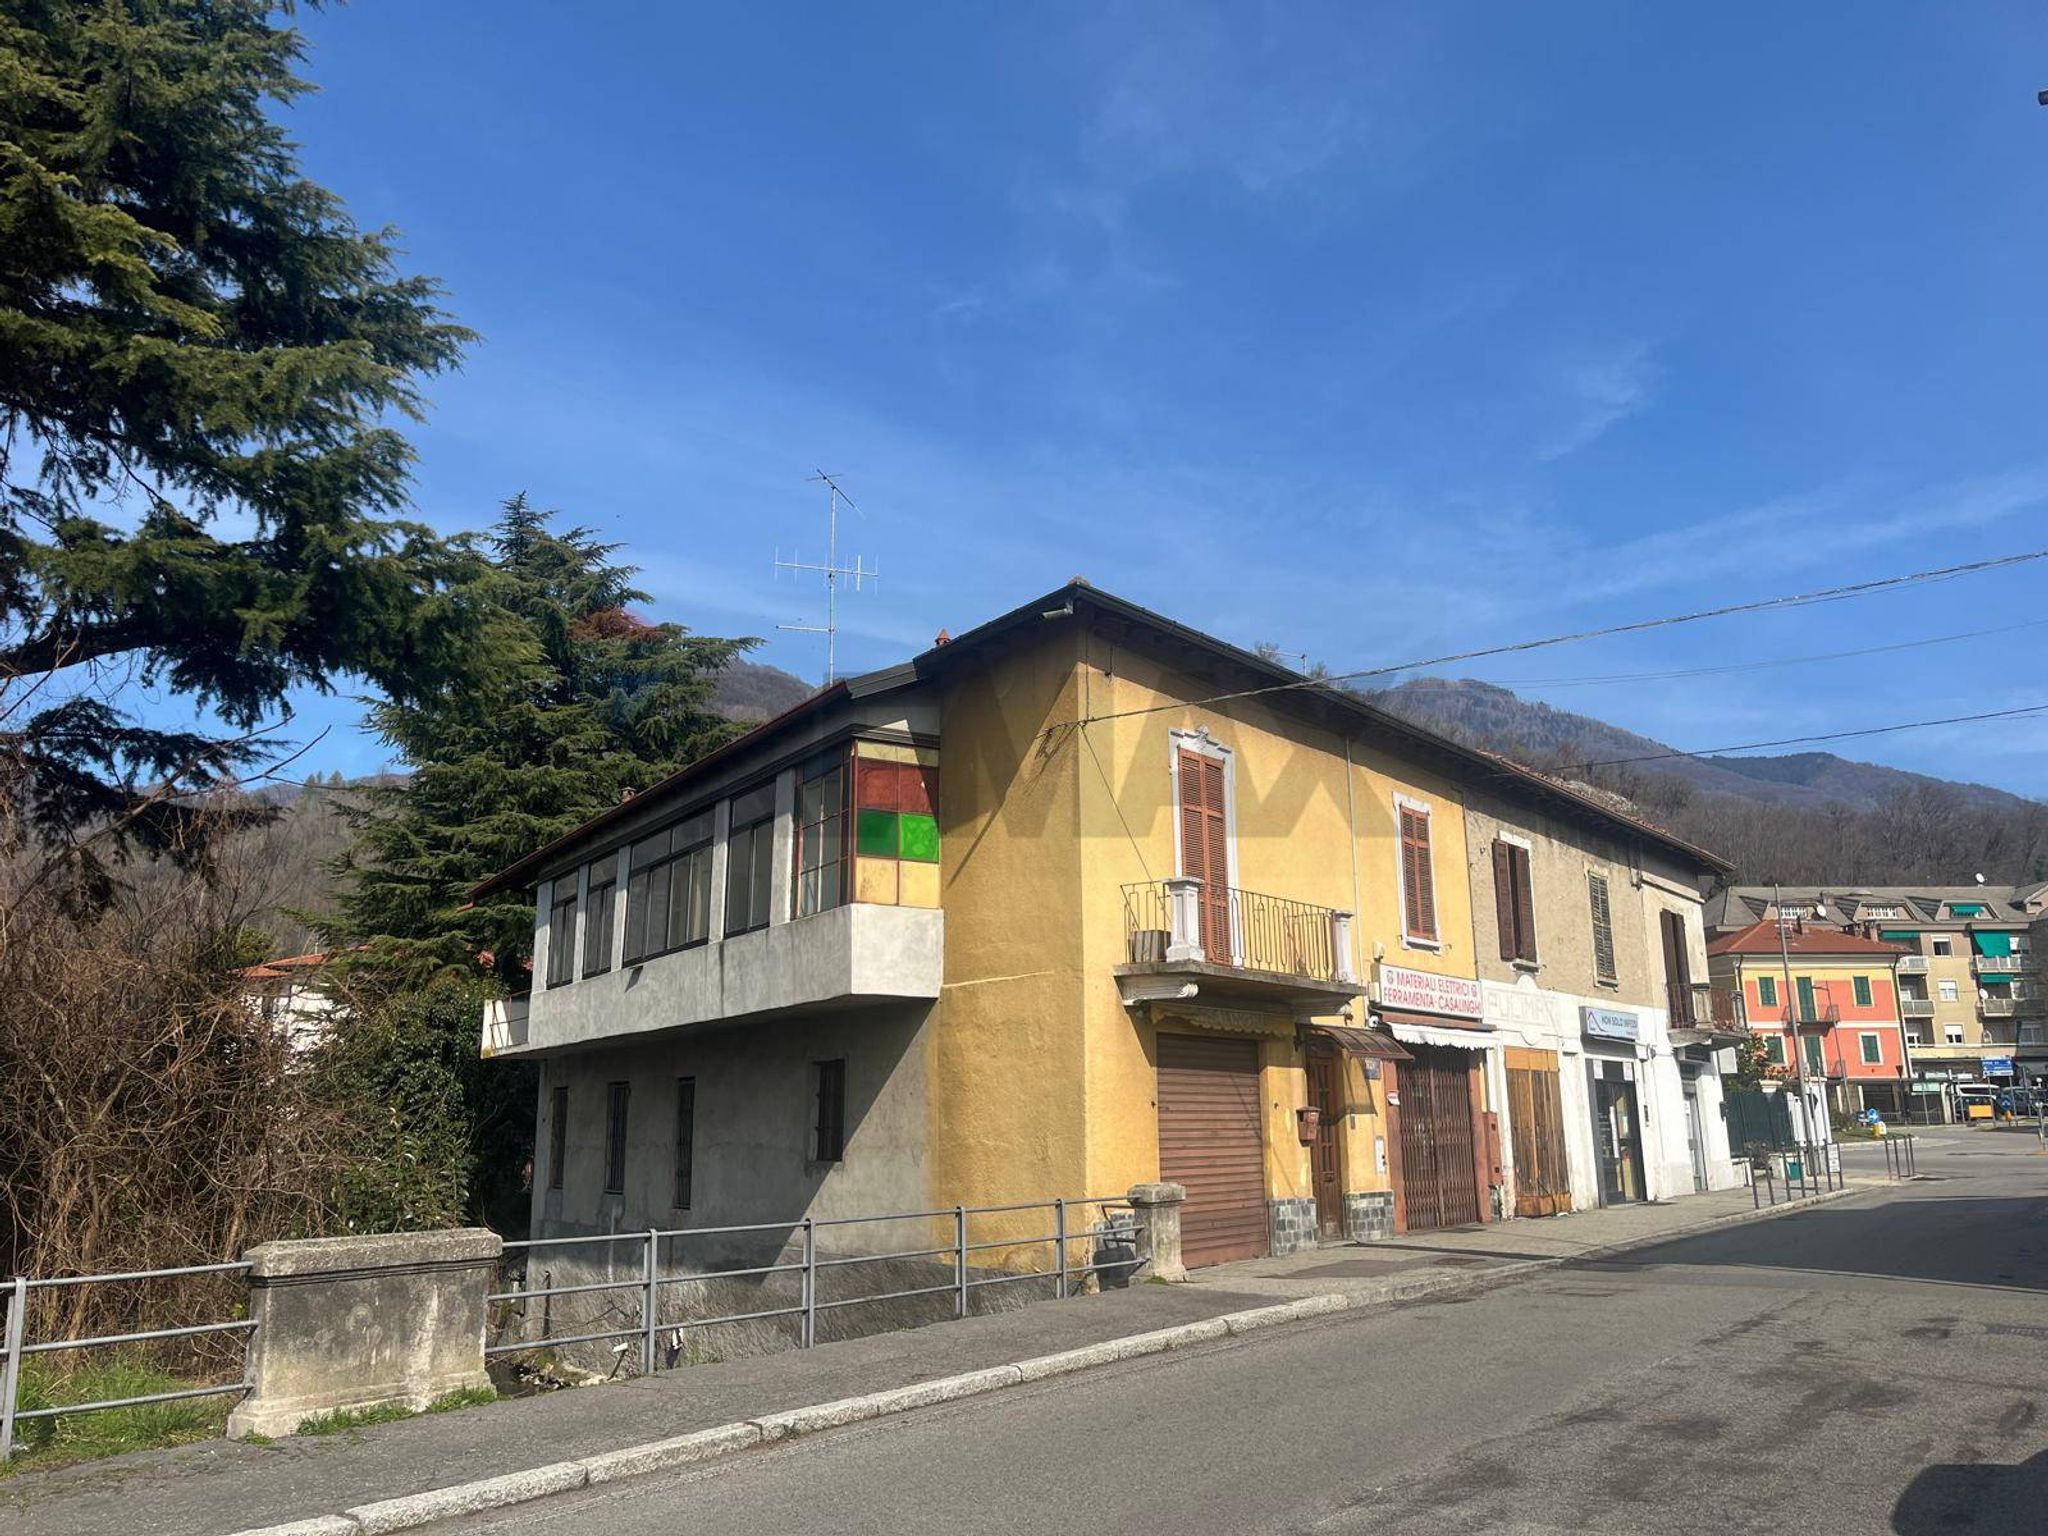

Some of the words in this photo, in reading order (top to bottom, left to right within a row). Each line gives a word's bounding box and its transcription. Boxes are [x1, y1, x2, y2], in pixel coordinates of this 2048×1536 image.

[1397, 972, 1436, 991] MATERIALI
[1438, 979, 1469, 996] ELETTRICI
[1383, 987, 1434, 1007] FERRAMENTA
